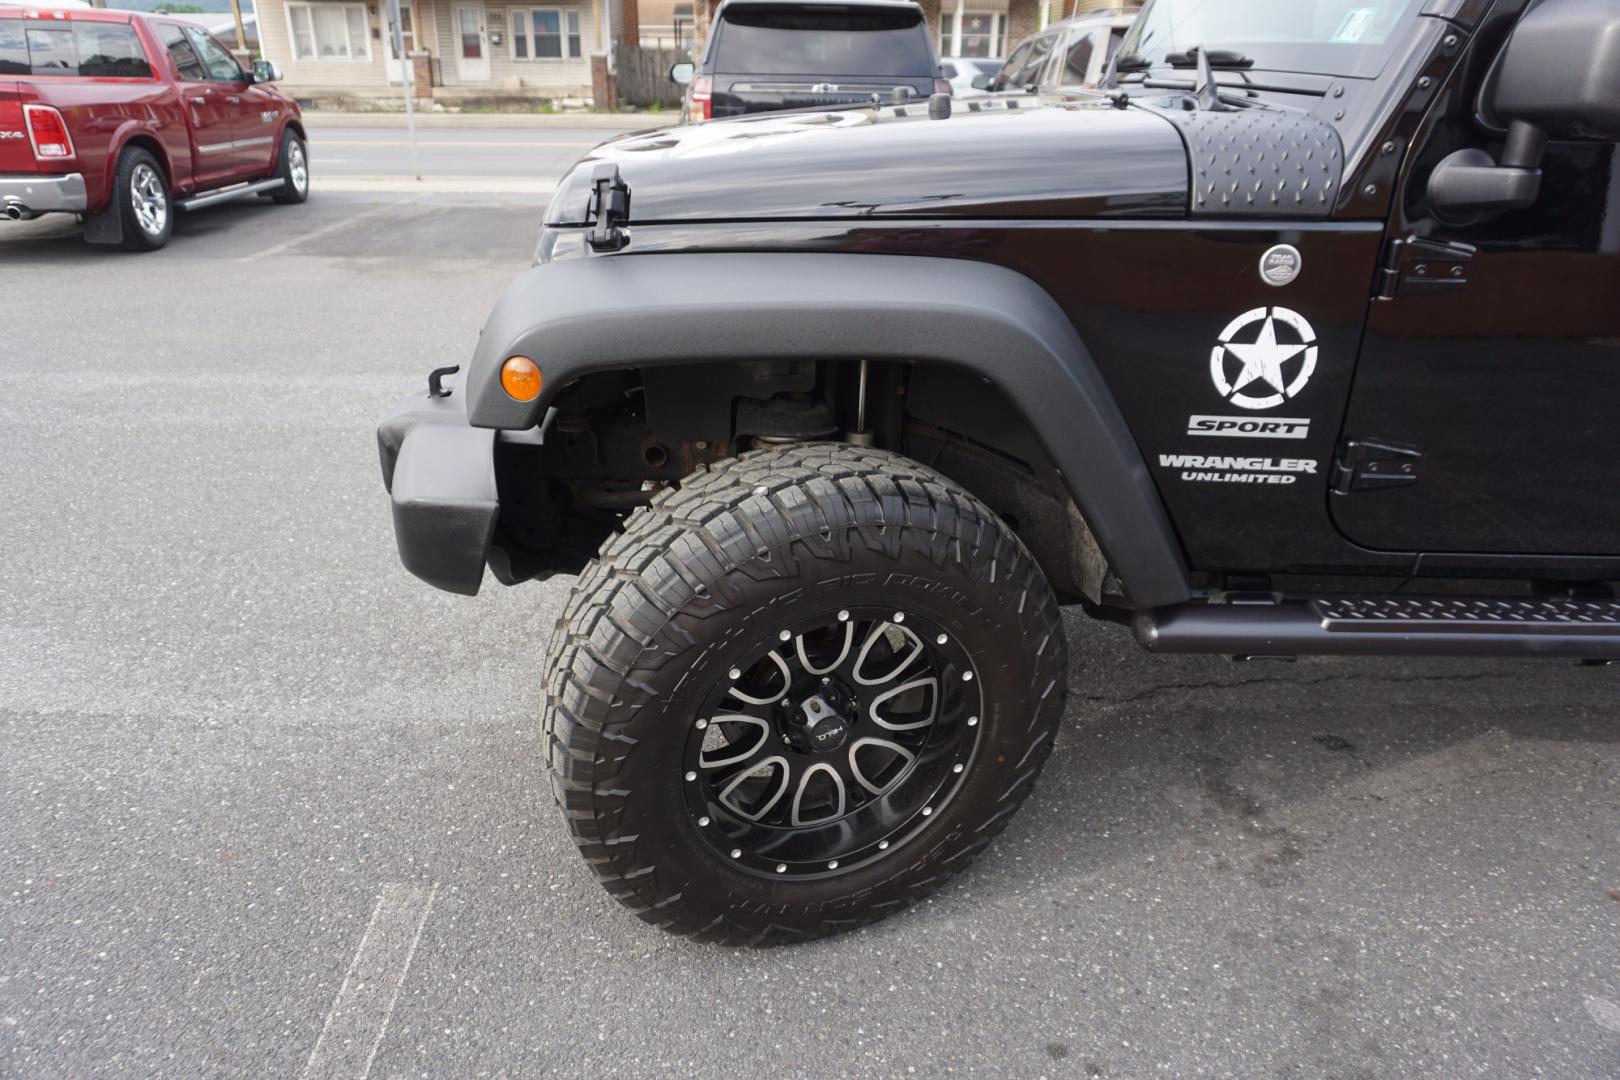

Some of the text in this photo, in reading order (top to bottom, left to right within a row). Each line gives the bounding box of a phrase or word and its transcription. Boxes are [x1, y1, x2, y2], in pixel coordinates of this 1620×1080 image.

[1196, 419, 1309, 434] SPORT
[1158, 454, 1318, 474] WRANGLER
[1180, 471, 1297, 485] UNLIMITED
